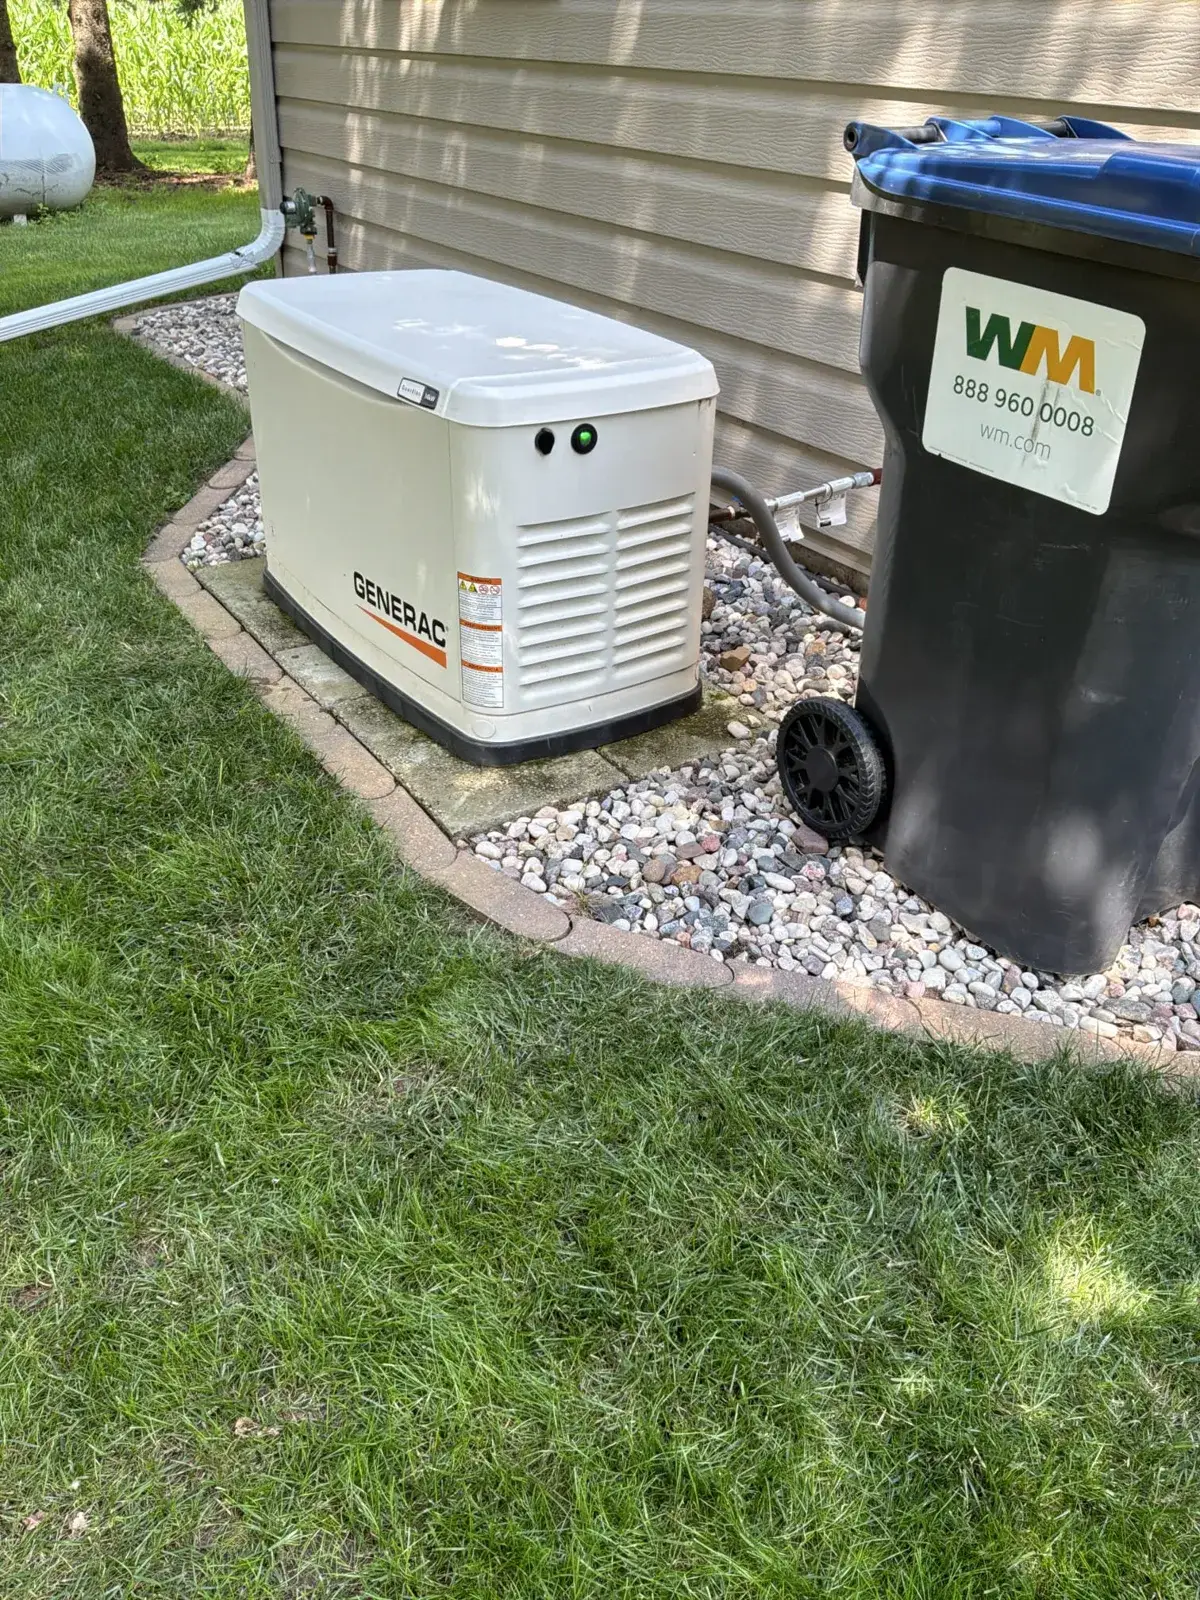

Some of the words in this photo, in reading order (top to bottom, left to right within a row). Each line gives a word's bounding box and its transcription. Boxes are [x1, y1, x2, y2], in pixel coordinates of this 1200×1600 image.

[965, 305, 1096, 395] WM
[953, 374, 989, 403] 888
[994, 388, 1034, 417] 960
[1039, 402, 1095, 437] 0008
[980, 423, 1051, 460] wm.com
[353, 571, 446, 648] GENERAC
